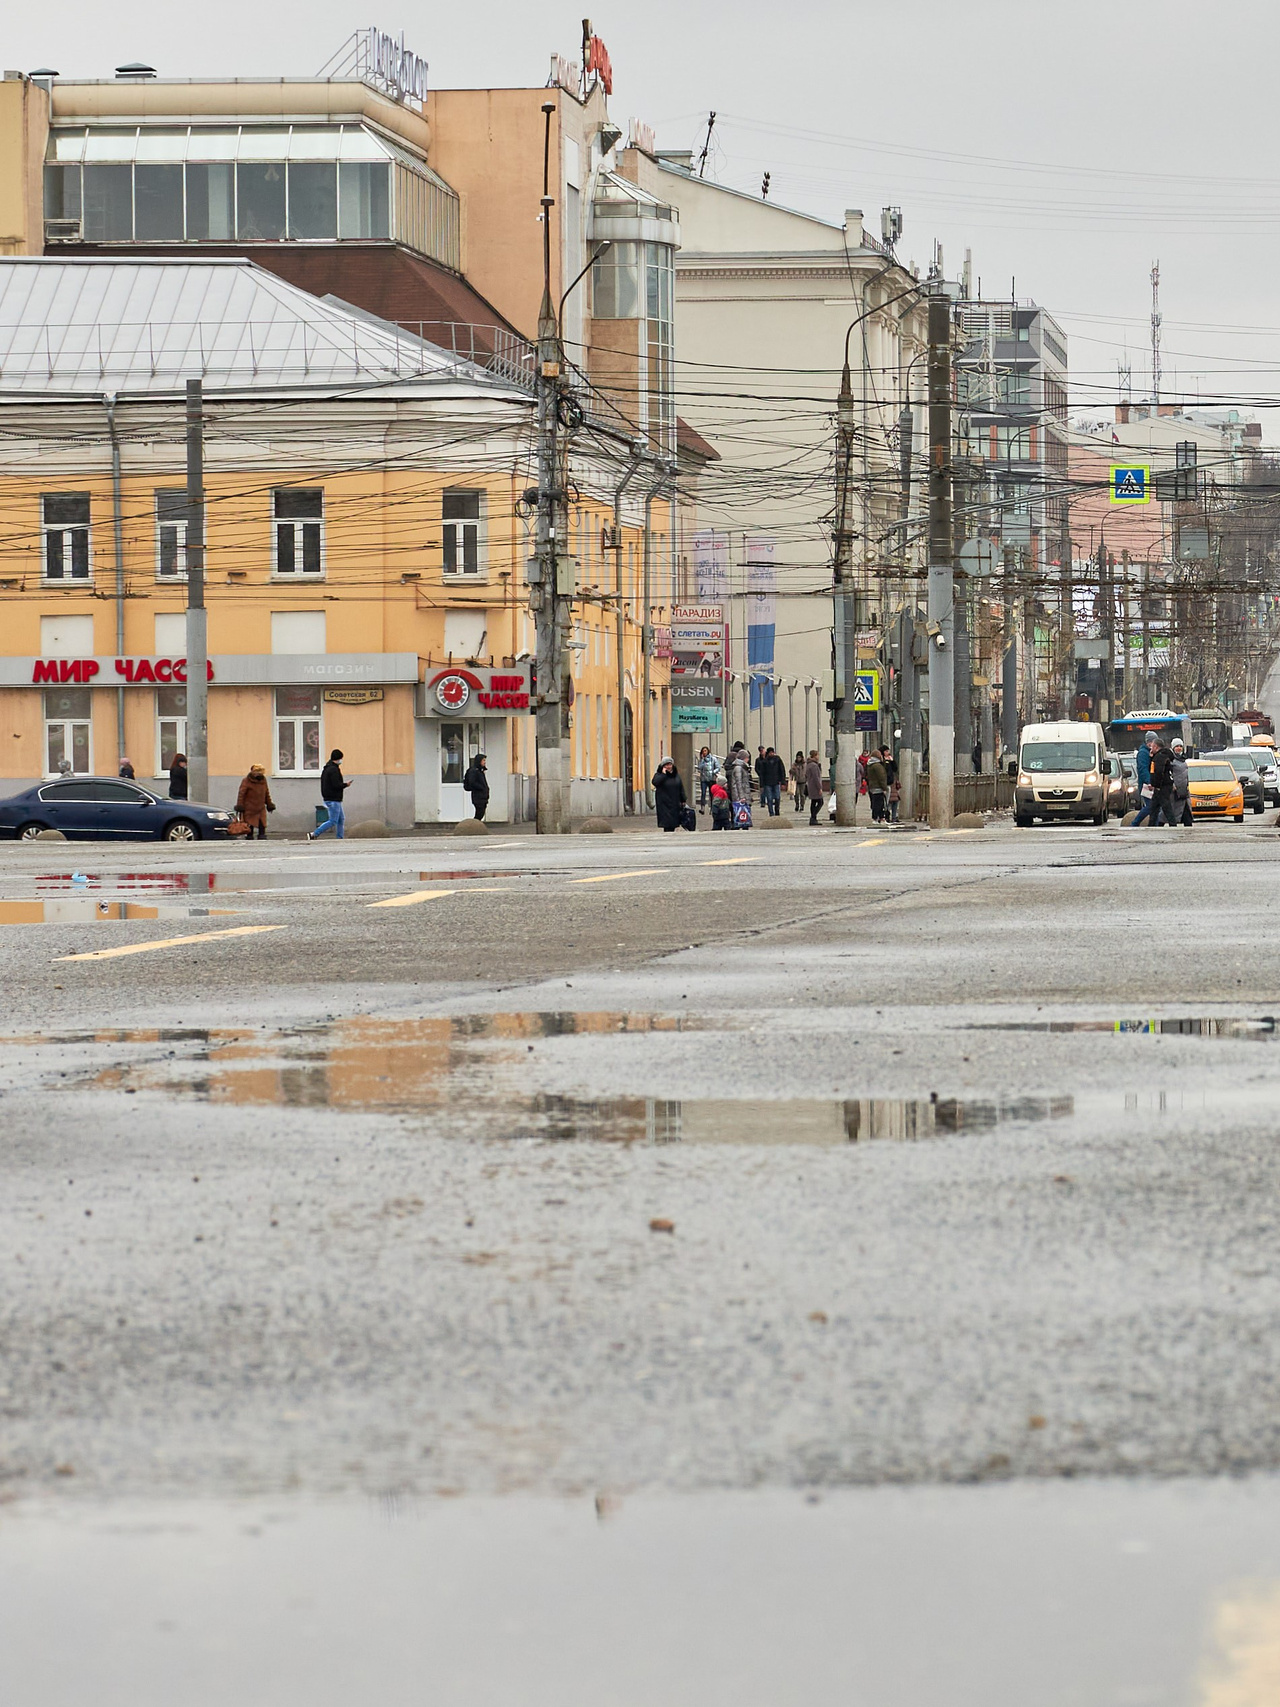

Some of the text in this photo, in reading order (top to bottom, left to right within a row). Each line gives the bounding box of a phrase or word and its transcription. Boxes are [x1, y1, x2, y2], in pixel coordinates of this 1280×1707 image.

[675, 609, 721, 618] ПАРАДИЗ
[32, 660, 99, 683] МИР
[303, 664, 374, 674] магазин
[491, 676, 524, 691] МИР
[329, 690, 366, 698] Советская
[672, 687, 714, 696] OLSEN
